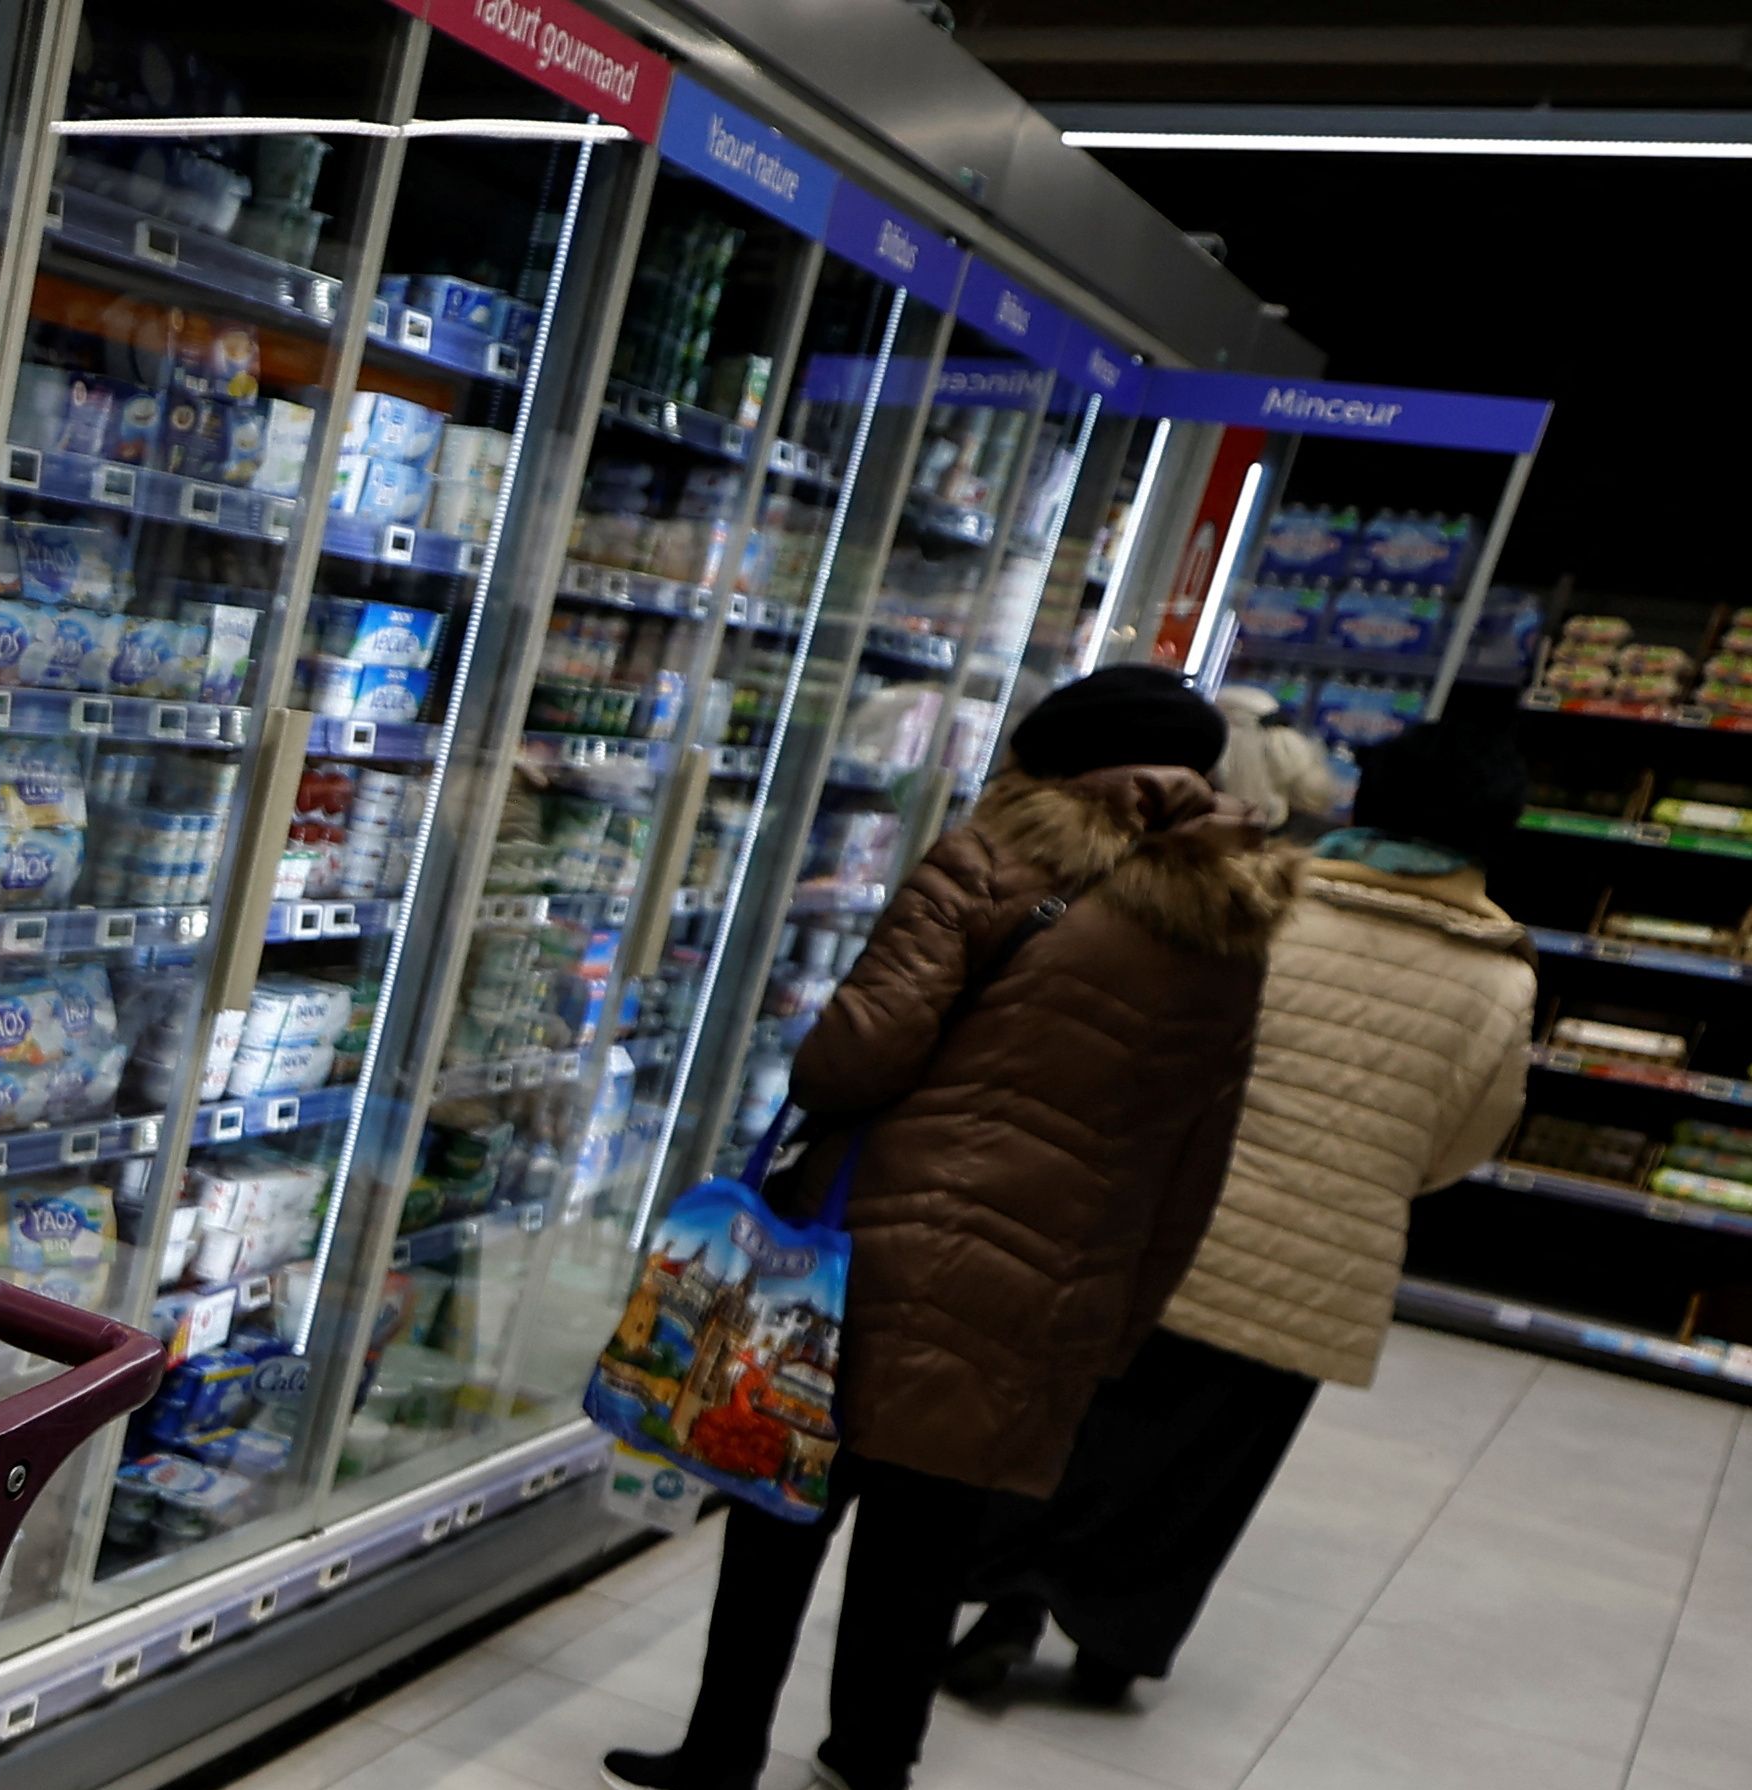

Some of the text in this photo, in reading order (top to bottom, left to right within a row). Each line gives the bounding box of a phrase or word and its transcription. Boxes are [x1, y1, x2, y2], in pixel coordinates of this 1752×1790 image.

[472, 0, 638, 103] Yaourt gourmand
[706, 116, 799, 202] Yaourt nature
[1262, 385, 1403, 428] Minceur
[30, 1205, 78, 1240] YAOS
